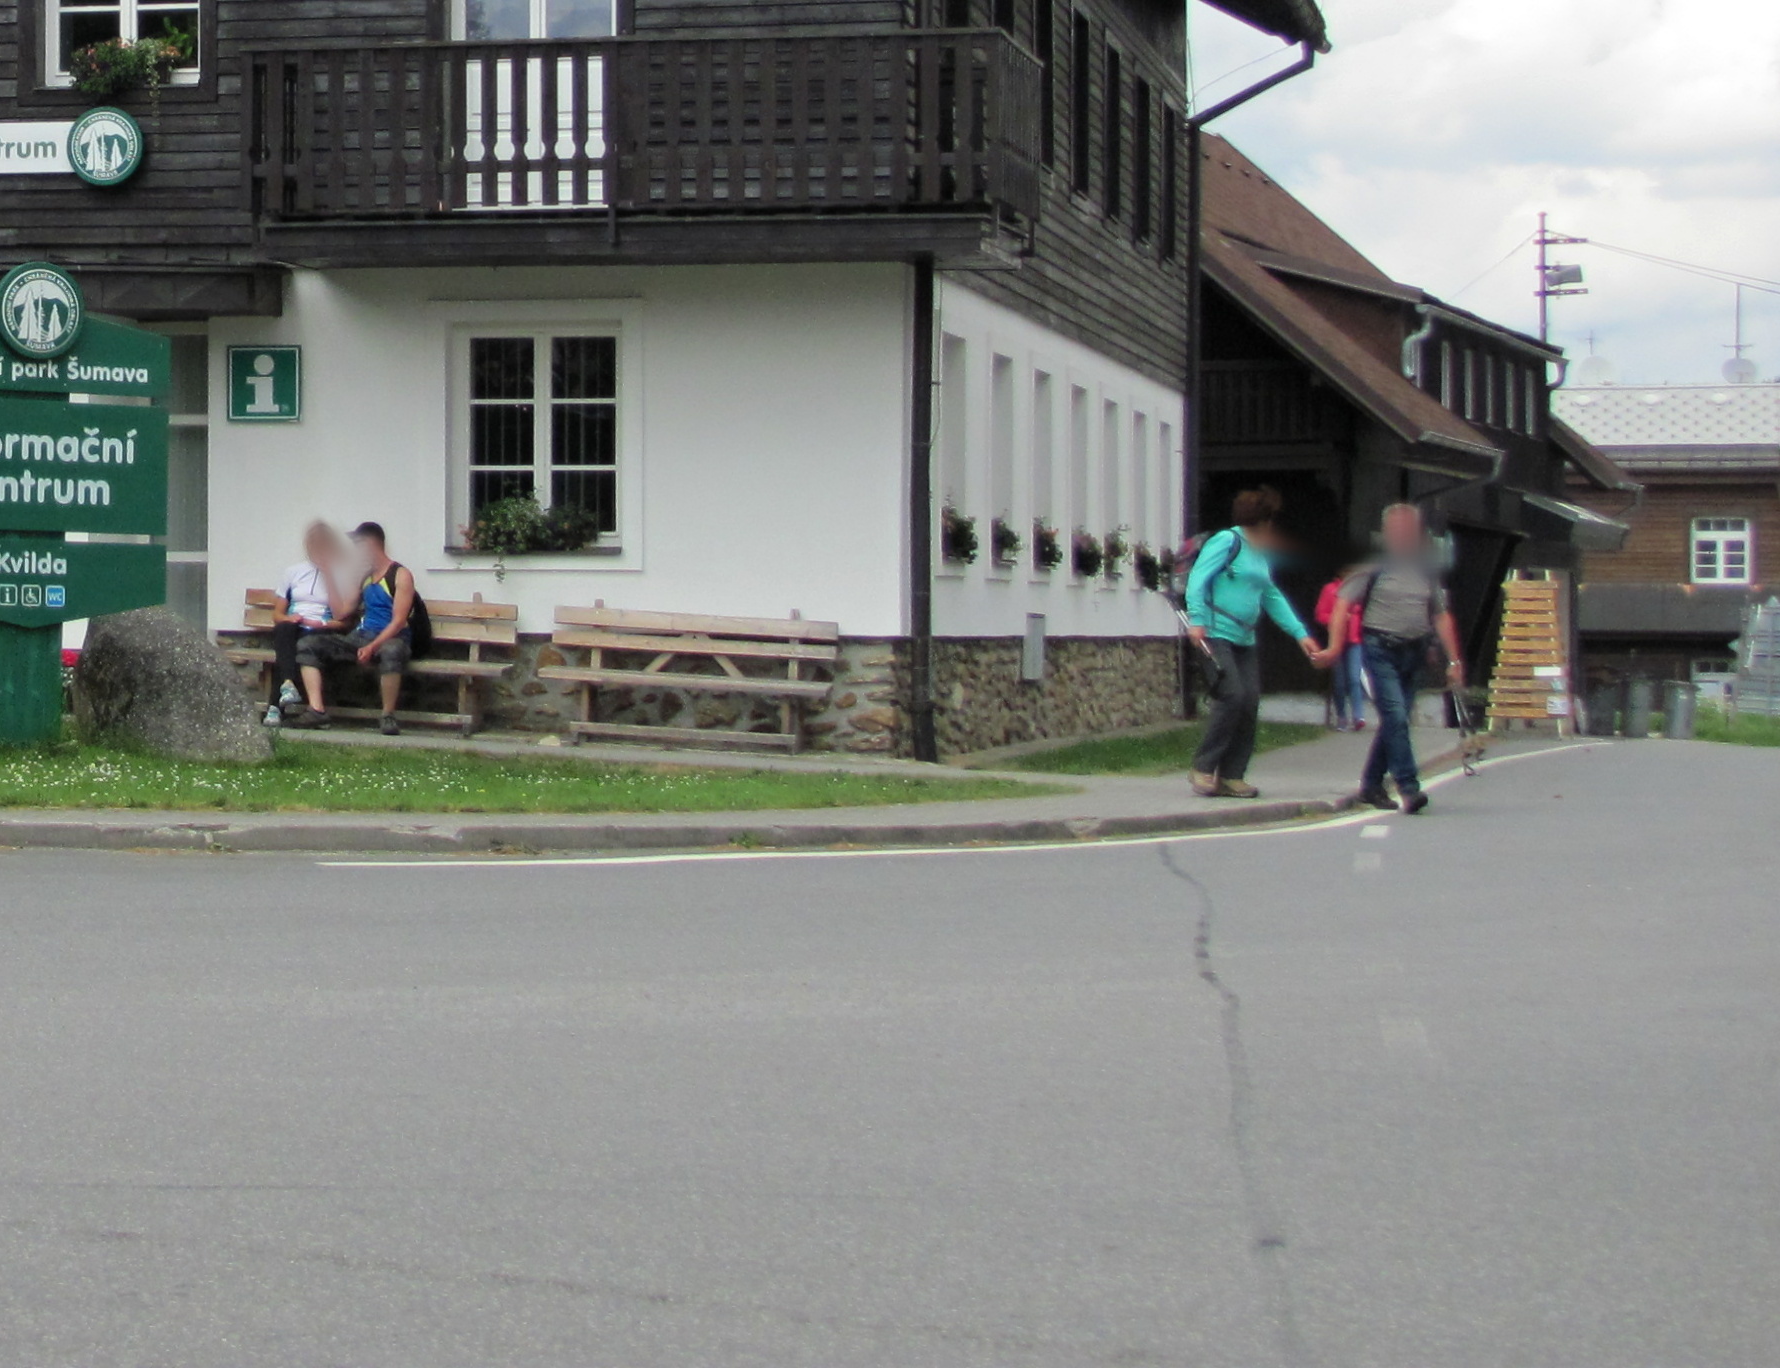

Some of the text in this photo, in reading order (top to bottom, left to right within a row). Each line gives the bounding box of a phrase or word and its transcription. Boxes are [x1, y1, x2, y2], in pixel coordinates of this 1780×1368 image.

[10, 357, 59, 380] park
[66, 355, 149, 384] Šumava
[47, 590, 64, 601] WC
